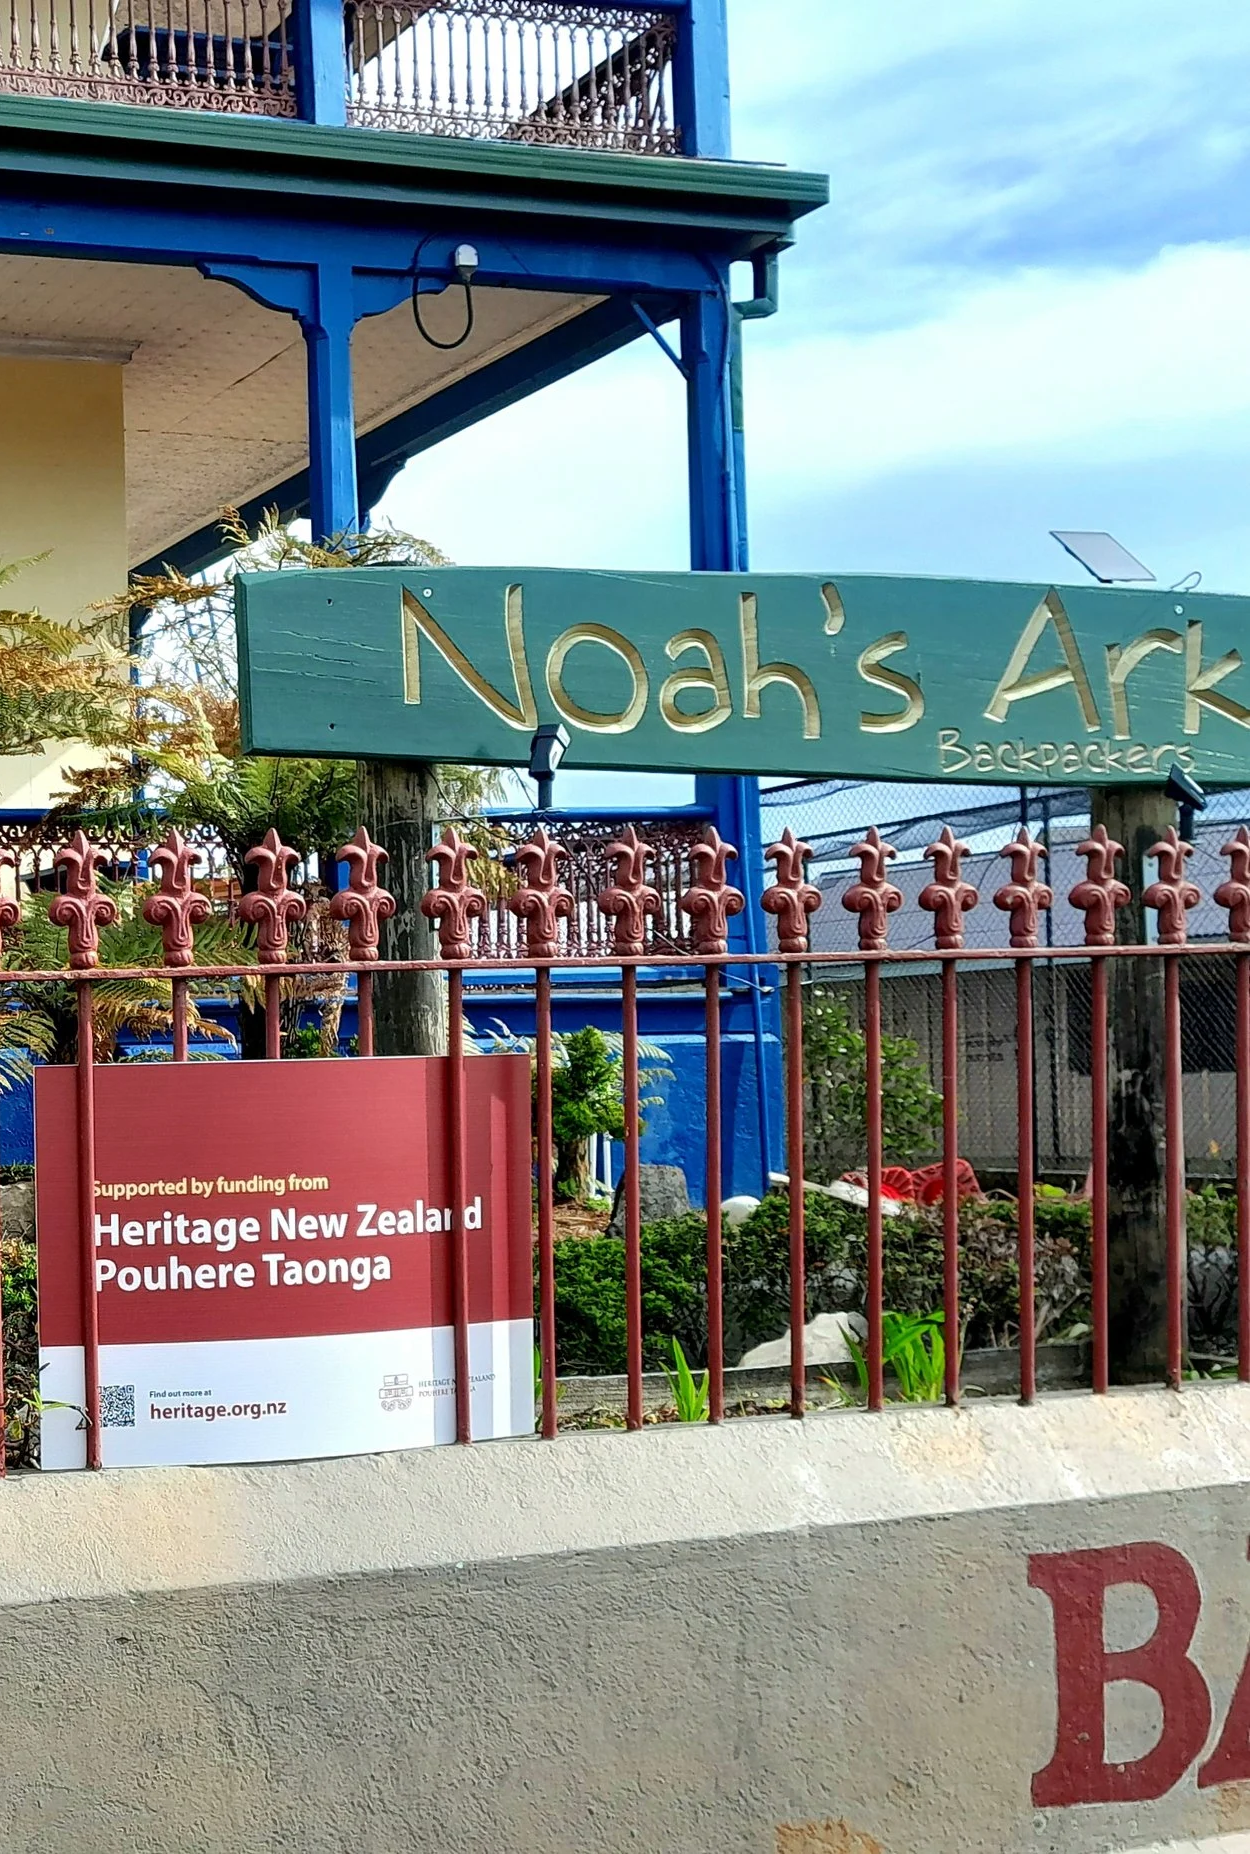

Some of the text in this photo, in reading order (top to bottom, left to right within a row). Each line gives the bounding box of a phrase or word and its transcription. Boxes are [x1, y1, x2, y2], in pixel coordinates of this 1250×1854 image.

[400, 582, 1250, 741] Noah's Ark
[938, 727, 1196, 778] Backpackers
[94, 1173, 329, 1201] Supported by funding from
[94, 1211, 261, 1252] Heritage
[270, 1208, 349, 1241] New
[95, 1253, 391, 1292] Pouhere Taonga
[149, 1390, 167, 1398] Find
[150, 1402, 287, 1421] heritage.org.nz
